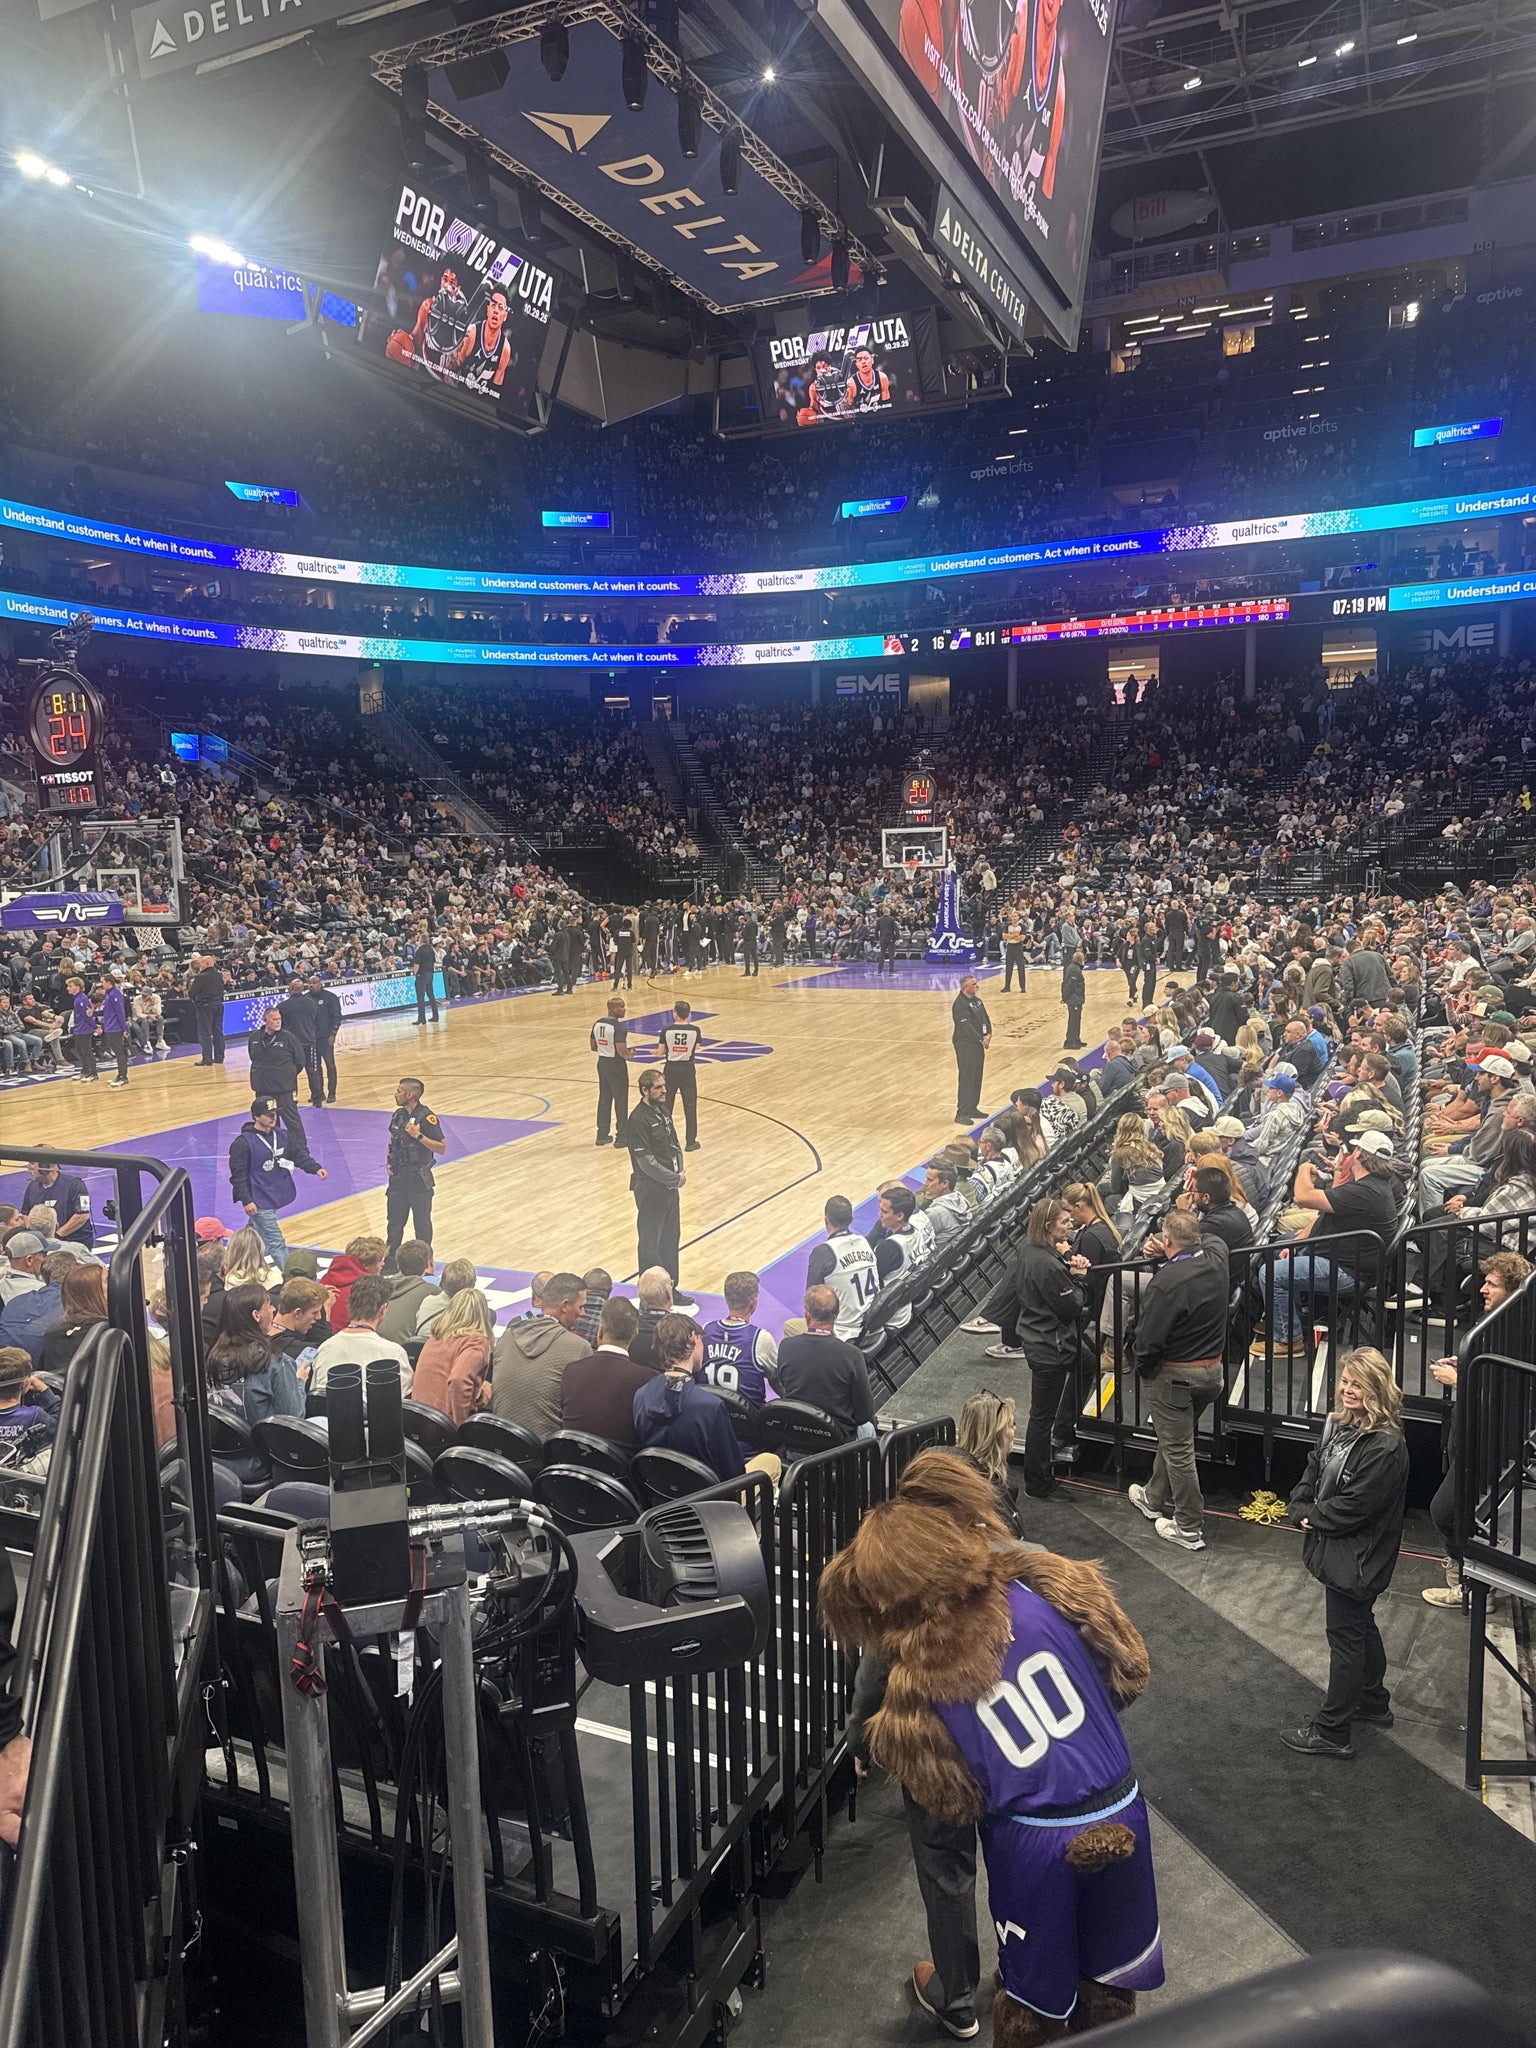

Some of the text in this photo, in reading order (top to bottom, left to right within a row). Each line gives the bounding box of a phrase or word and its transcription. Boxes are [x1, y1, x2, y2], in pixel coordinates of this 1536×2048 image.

[925, 33, 941, 64] VISIT
[982, 126, 990, 149] OR
[989, 138, 1001, 167] CALL
[598, 153, 780, 280] DELTA
[1139, 198, 1166, 220] bill
[393, 226, 441, 262] WEDNESDAY
[396, 185, 554, 312] POR VS. UTA
[952, 220, 1025, 327] DELTA CENTER
[1477, 285, 1523, 304] aptive
[523, 303, 549, 325] 10.29.25
[769, 317, 908, 362] POR VS. UTA
[884, 341, 909, 350] 10.29.25
[773, 357, 810, 370] WEDNESDAY
[1263, 419, 1338, 443] aptive lofts
[970, 460, 1034, 481] aptive lofts
[1455, 493, 1530, 514] Understand
[3, 506, 217, 560] Understand customers. Act when it counts.
[931, 539, 1141, 572] Understand customers. Act when it counts.
[481, 577, 680, 591] Understand customers. Act when it counts.
[1447, 581, 1521, 599] Understand
[1333, 595, 1387, 615] 07:19 PM
[6, 599, 218, 640] Understand cmers. Act when it counts.
[975, 630, 995, 646] 8:11
[1001, 636, 1010, 644] 1ST
[1109, 626, 1129, 634] (100%)
[911, 638, 919, 652] 2
[932, 636, 945, 650] 16
[481, 649, 679, 663] Understand customers. Act when it counts.
[836, 673, 900, 695] SME
[52, 692, 87, 715] 8:11
[838, 694, 897, 702] INDUSTRIE
[48, 714, 87, 756] 24
[55, 770, 94, 784] TISSOT
[912, 780, 930, 789] 8:11
[909, 788, 928, 804] 24
[943, 883, 951, 929] AMERICA FIRST
[600, 1026, 606, 1039] 11
[674, 1033, 687, 1045] 52
[839, 1250, 874, 1270] ANDERSON
[850, 1268, 879, 1306] 14
[707, 1344, 742, 1362] BAILEY
[793, 1424, 832, 1437] entrata
[976, 1651, 1085, 1768] 00
